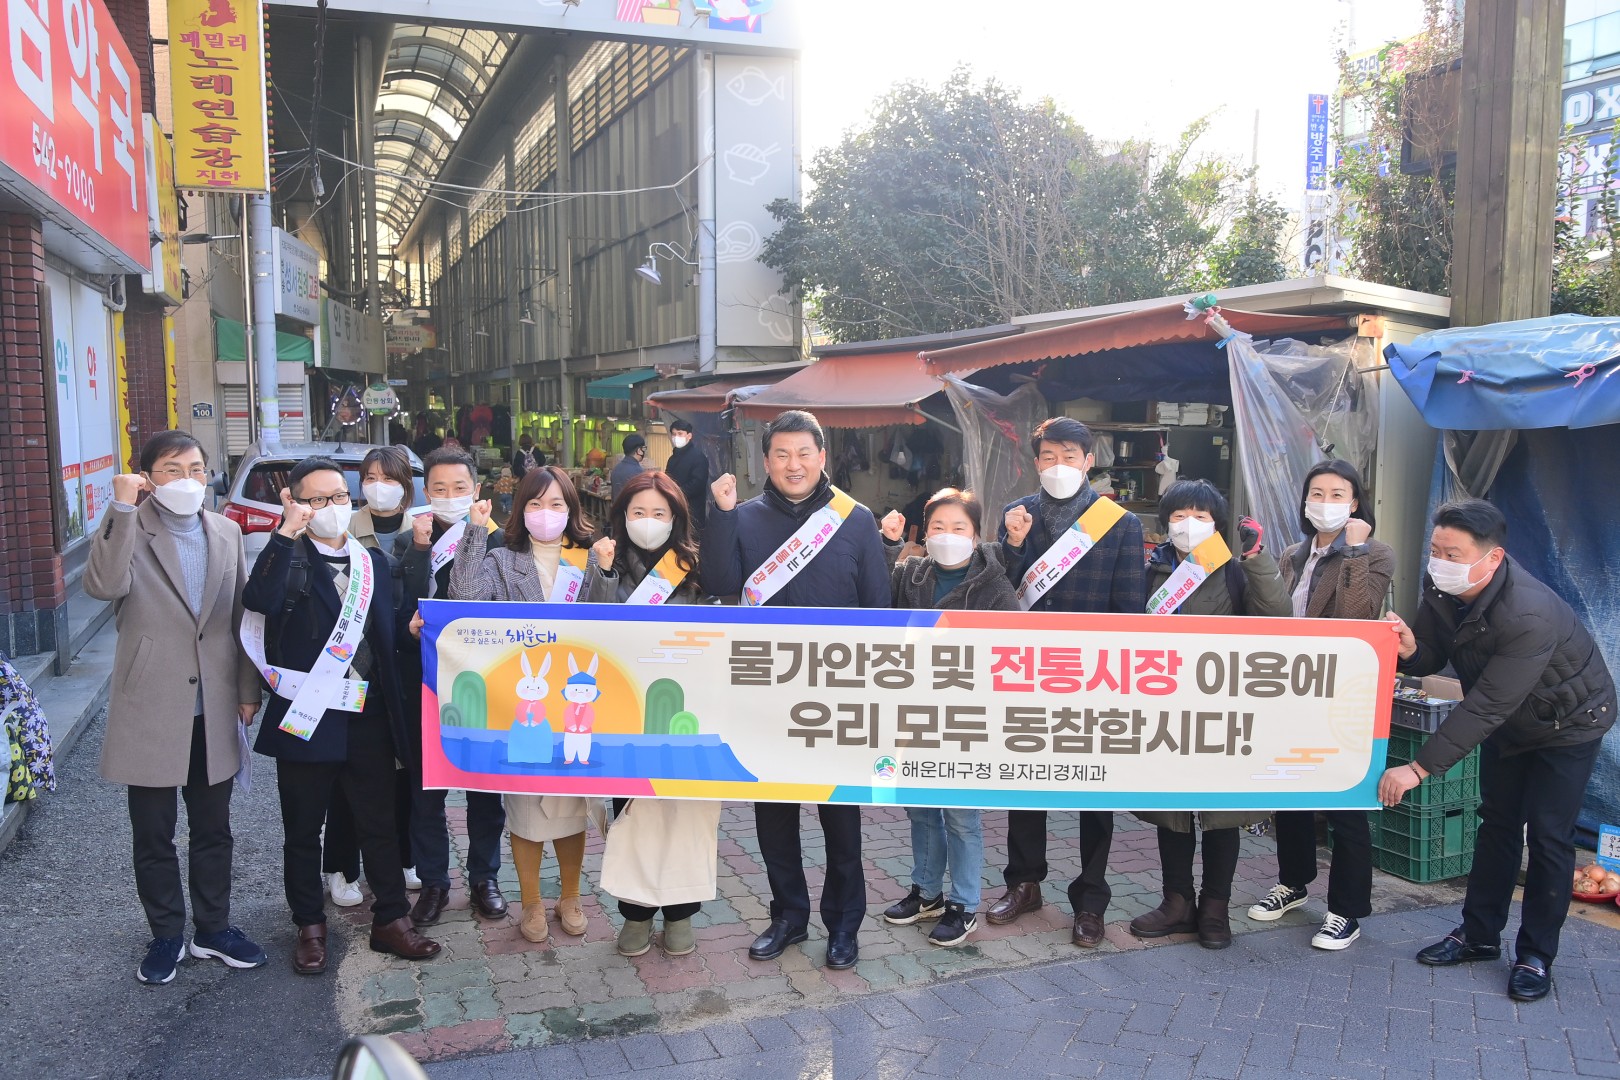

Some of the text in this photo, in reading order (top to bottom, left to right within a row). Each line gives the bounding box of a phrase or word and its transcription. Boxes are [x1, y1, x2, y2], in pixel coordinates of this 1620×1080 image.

[179, 31, 247, 51] 패밀리
[187, 49, 242, 168] 노래연습장
[32, 121, 95, 213] 542-9000
[196, 170, 241, 181] 지하
[87, 345, 97, 400] 약
[366, 397, 393, 405] 안동상회
[196, 409, 210, 417] 100
[752, 537, 803, 586] 전통시장
[456, 628, 469, 636] 살기
[470, 628, 483, 637] 좋은
[463, 636, 476, 644] 오고
[477, 637, 490, 645] 싶은
[505, 628, 557, 648] 해운대
[729, 640, 1338, 698] 물가안정 및 전통시장 이용에
[788, 701, 1255, 756] 우리 모두 동참합시다!
[901, 760, 1108, 782] 해운대구청 일자리경제과
